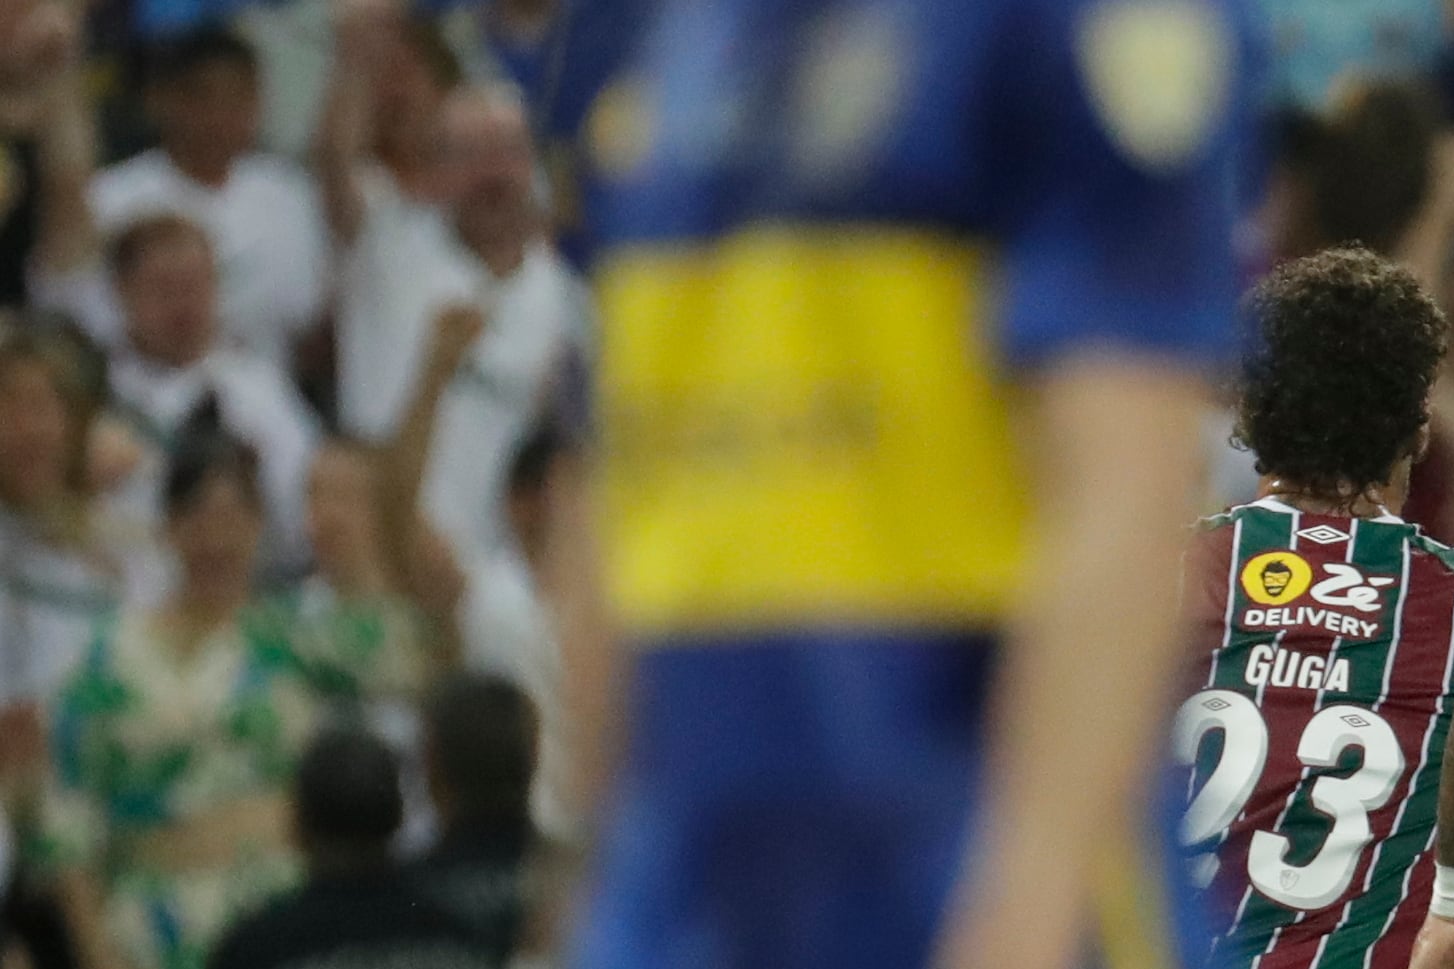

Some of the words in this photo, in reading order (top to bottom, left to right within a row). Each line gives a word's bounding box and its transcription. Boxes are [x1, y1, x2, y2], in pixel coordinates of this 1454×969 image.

[1309, 563, 1394, 612] Zé
[1244, 606, 1378, 638] DELIVERY
[1244, 644, 1350, 692] GUGA
[1172, 689, 1406, 911] 23
